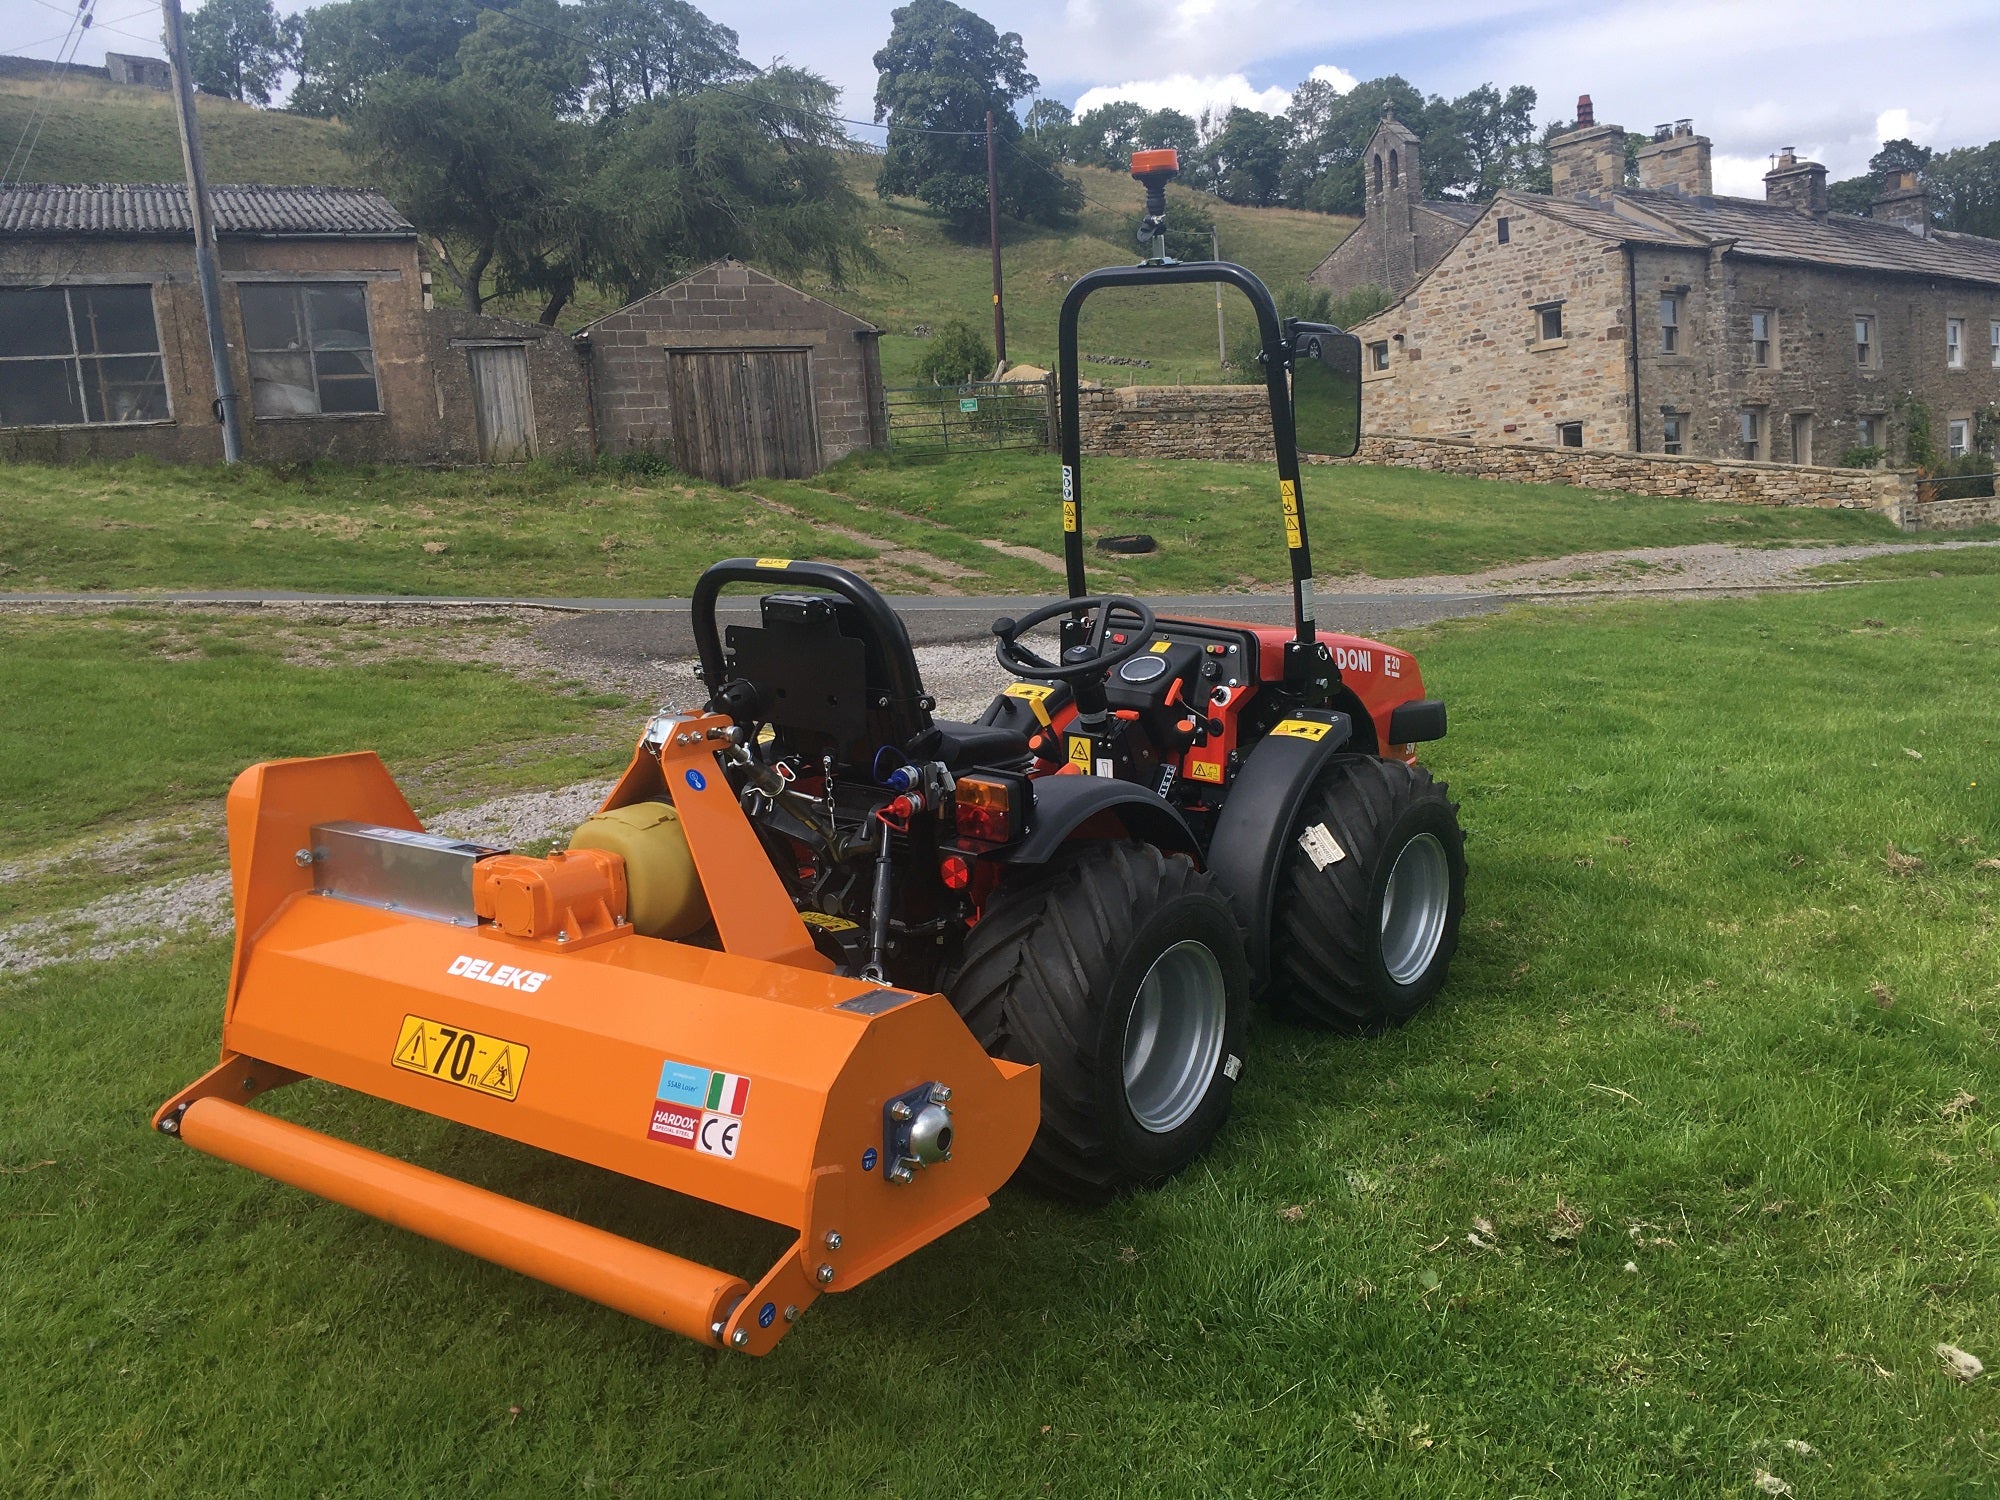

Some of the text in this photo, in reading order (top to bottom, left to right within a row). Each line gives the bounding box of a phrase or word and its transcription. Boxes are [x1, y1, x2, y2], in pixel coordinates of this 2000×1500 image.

[446, 955, 547, 993] DELEKS
[433, 1027, 476, 1082] 70
[653, 1110, 697, 1130] HARDOX
[655, 1124, 691, 1138] SPECIAL STEEL
